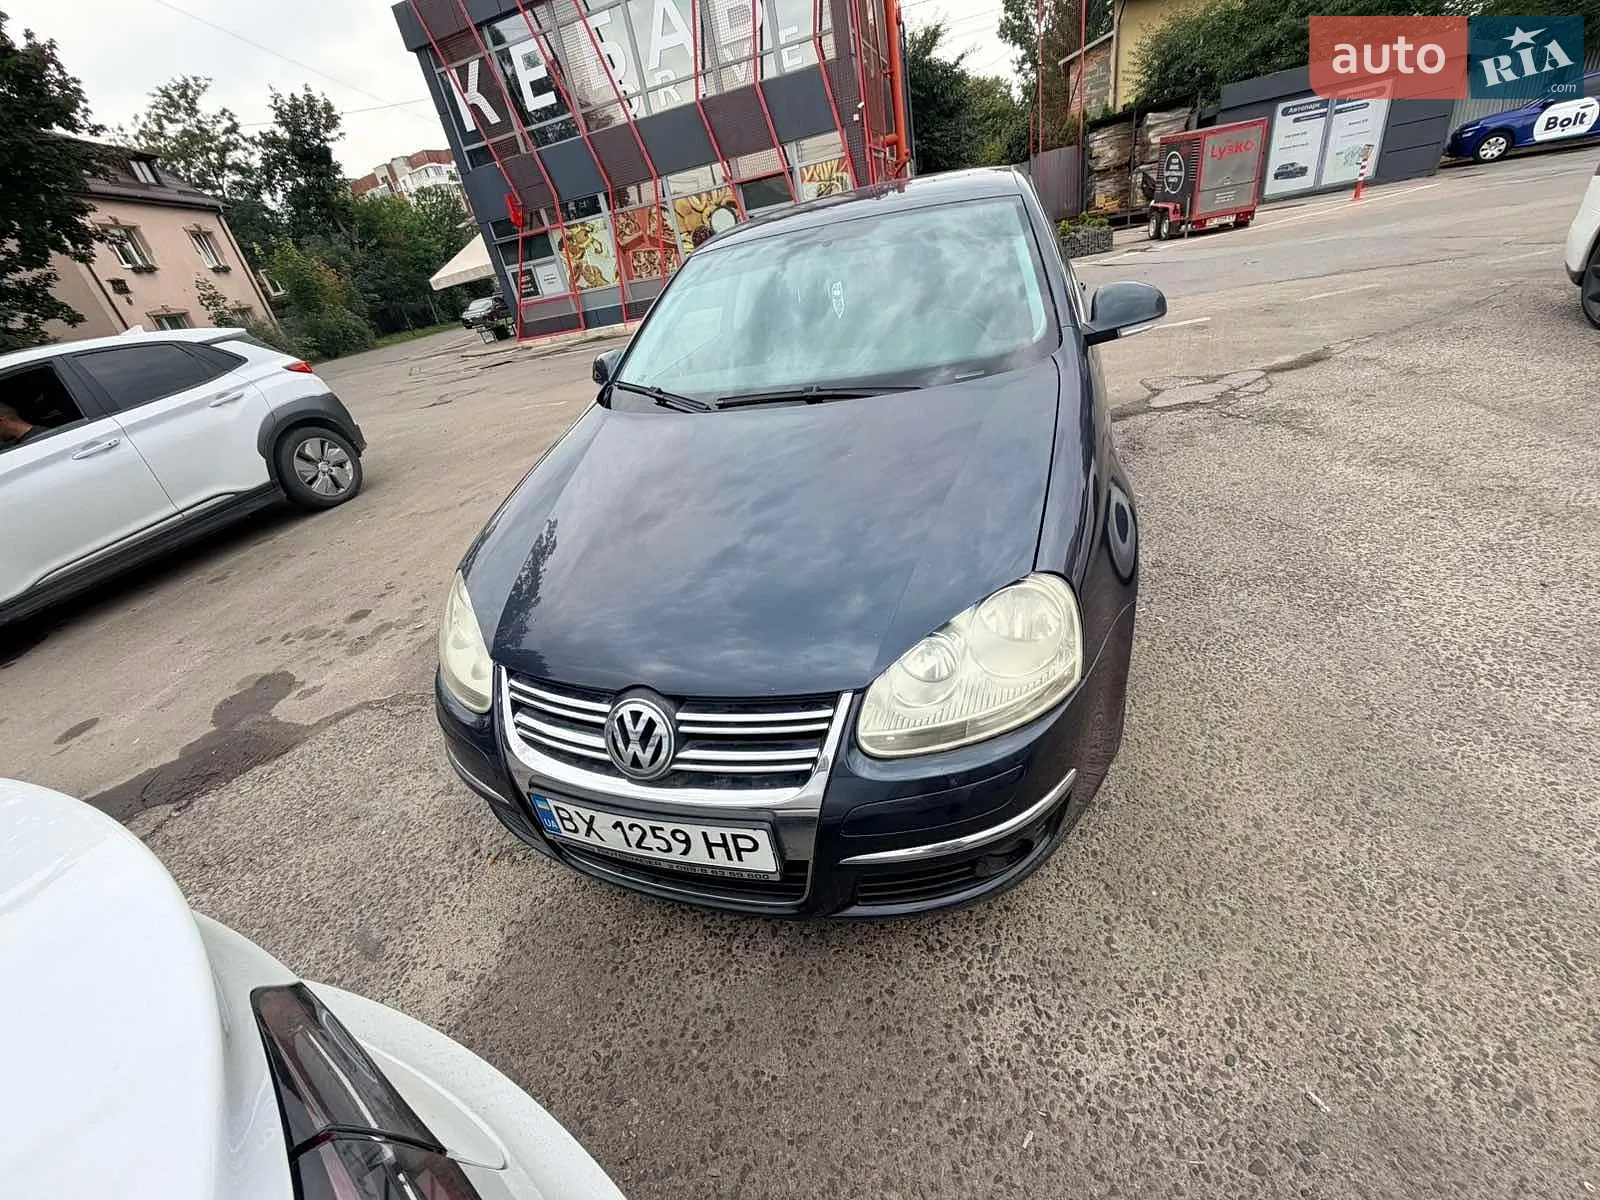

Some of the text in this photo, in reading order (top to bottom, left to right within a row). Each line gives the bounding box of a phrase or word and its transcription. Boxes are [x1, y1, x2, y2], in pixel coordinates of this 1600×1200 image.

[1544, 112, 1588, 131] Bolt
[544, 816, 560, 829] UA
[553, 804, 605, 842] BX
[612, 819, 692, 856] 1259
[701, 831, 760, 862] HP
